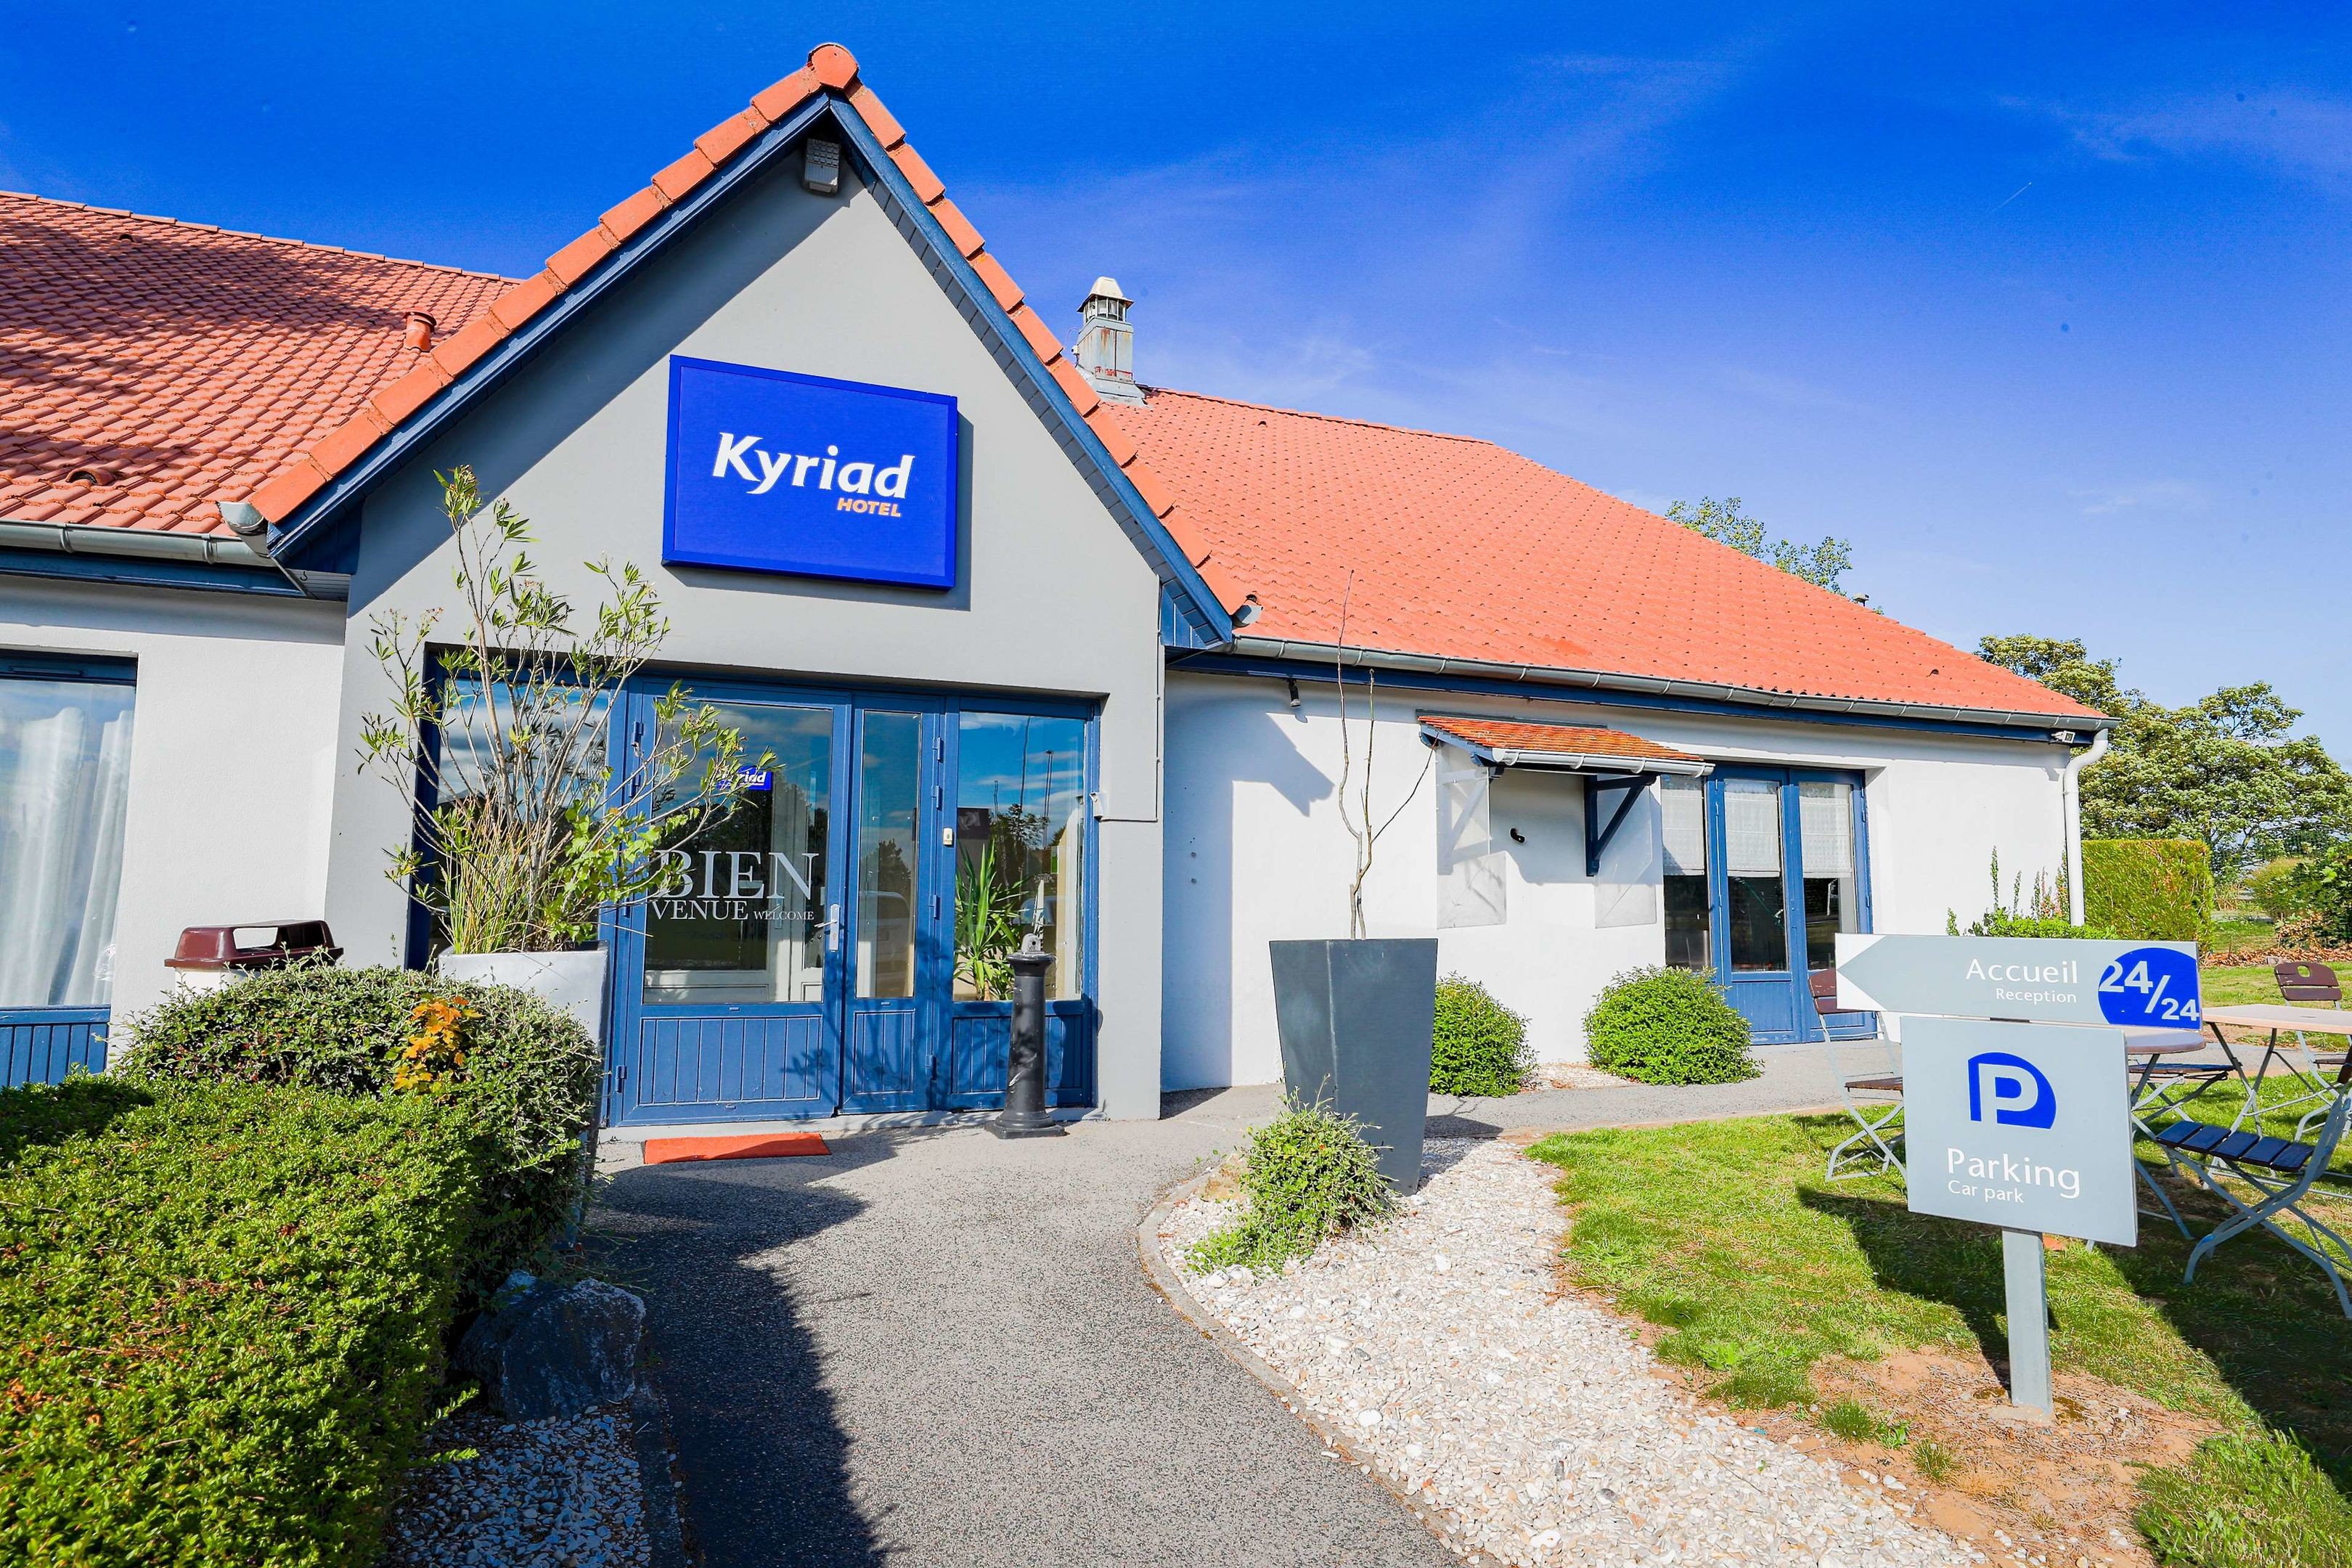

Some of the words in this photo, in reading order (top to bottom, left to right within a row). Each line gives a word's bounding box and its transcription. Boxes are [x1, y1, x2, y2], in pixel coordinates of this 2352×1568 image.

[712, 432, 915, 499] Kyriad
[837, 498, 901, 517] HOTEL
[650, 849, 819, 900] BIEN
[652, 900, 748, 920] VENUE
[754, 910, 814, 920] WELCOME
[1965, 958, 2078, 984] Accueil
[1996, 988, 2077, 1005] Reception
[2099, 960, 2199, 1021] 24/24
[1977, 1063, 2039, 1124] P
[1947, 1147, 2081, 1199] Parking
[1948, 1180, 1977, 1196] Car
[1984, 1187, 2024, 1203] park
